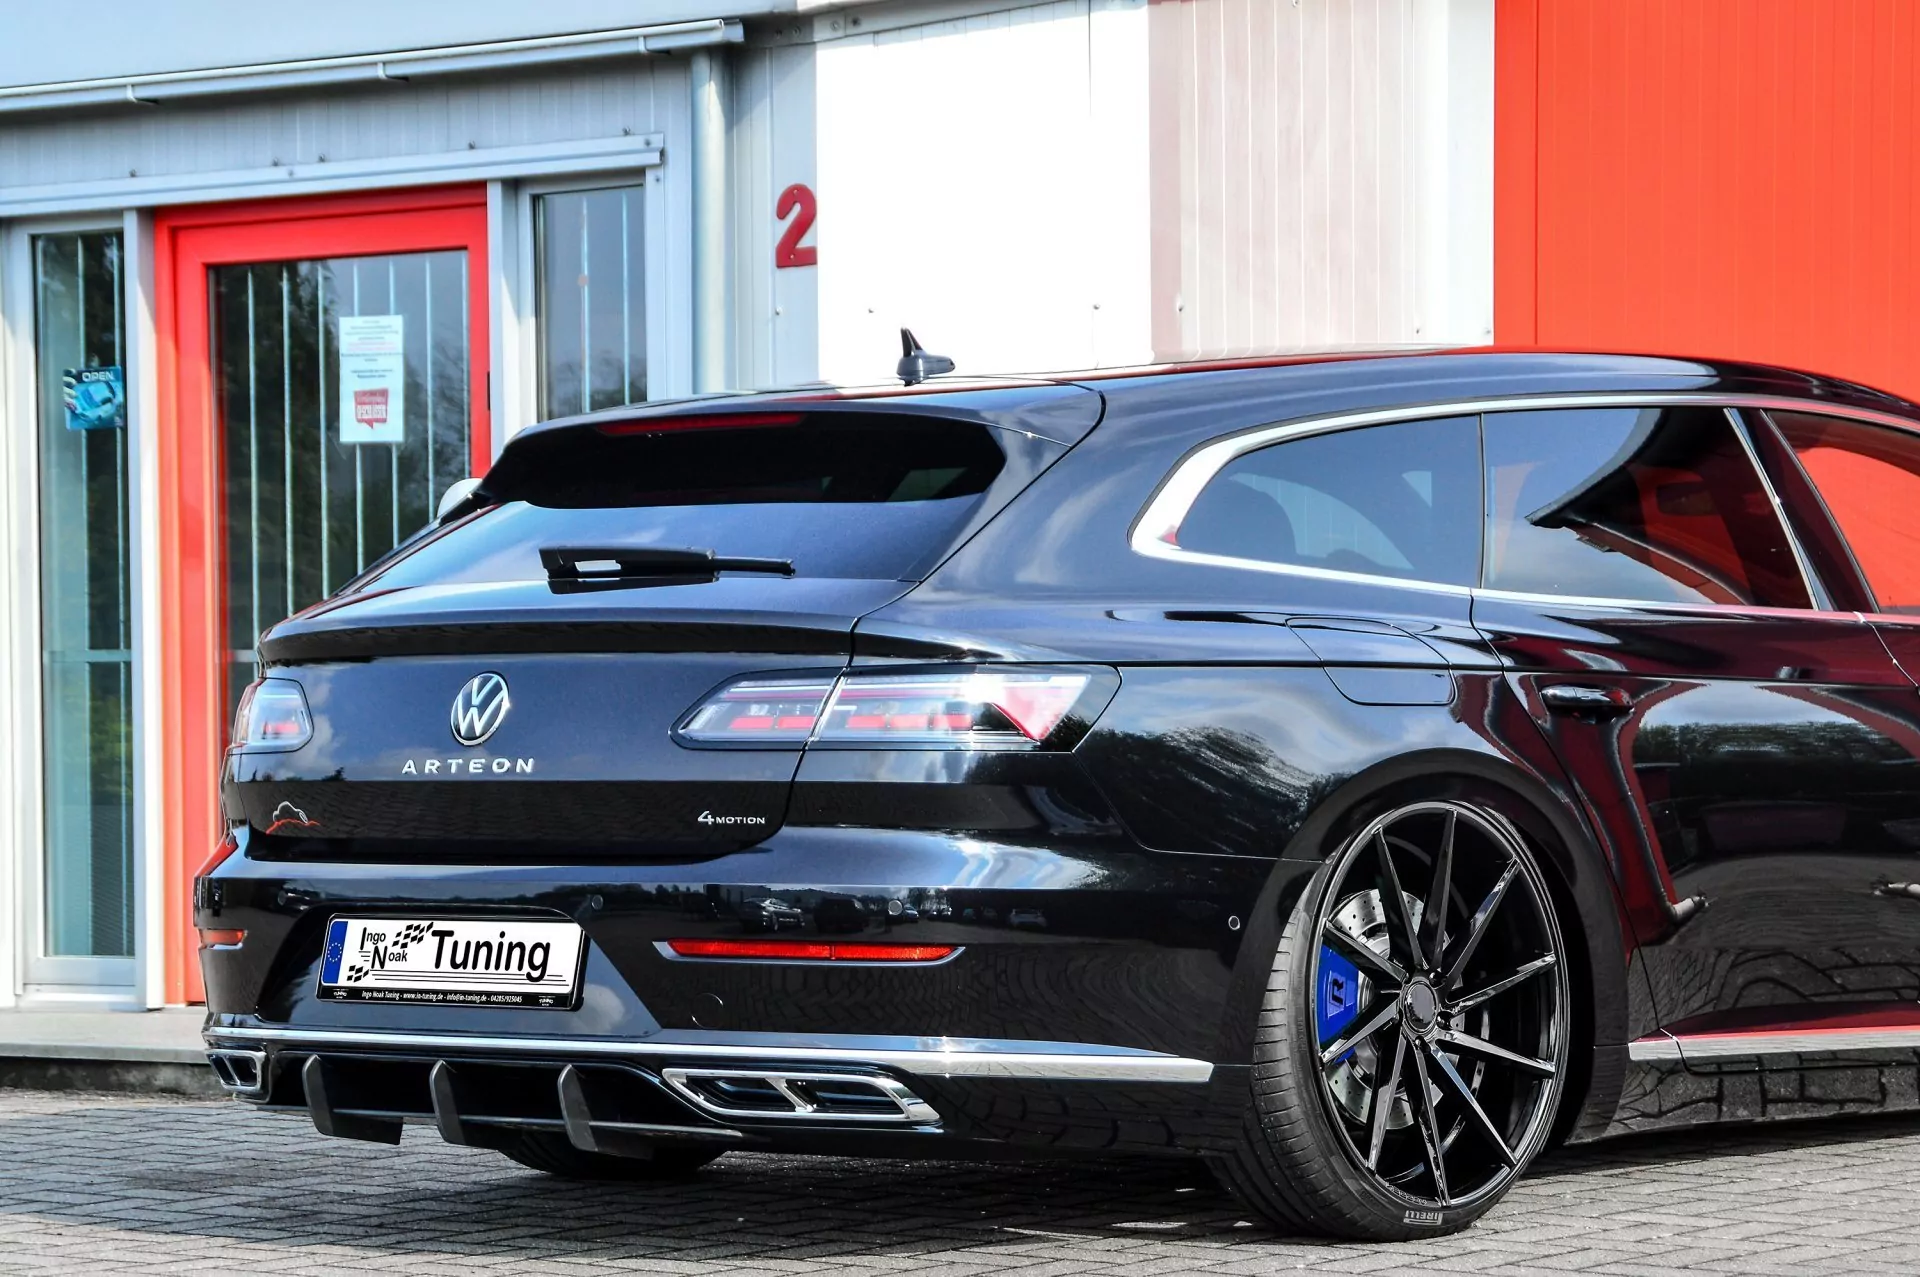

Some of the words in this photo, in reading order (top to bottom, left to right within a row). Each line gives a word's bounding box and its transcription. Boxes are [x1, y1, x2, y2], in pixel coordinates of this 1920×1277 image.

[776, 184, 816, 268] 2
[82, 371, 115, 382] OPEN
[402, 758, 535, 774] ARTEON
[697, 810, 766, 825] 4MOTION
[360, 927, 387, 951] Ingo
[371, 945, 408, 970] Noak
[431, 929, 551, 983] Tuning
